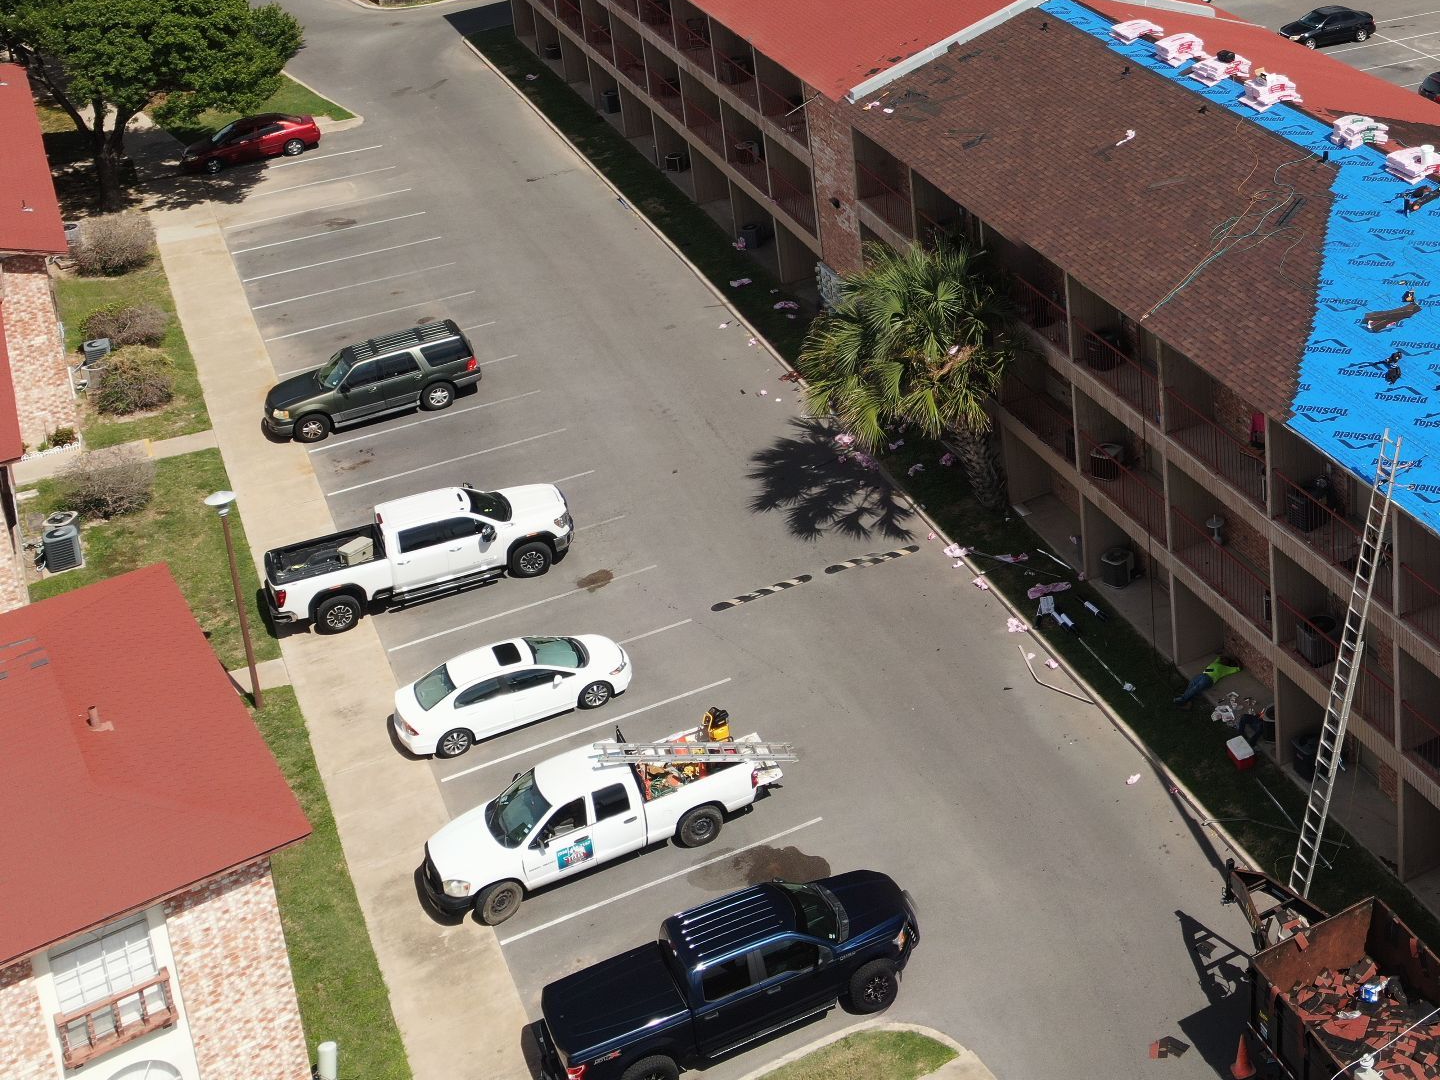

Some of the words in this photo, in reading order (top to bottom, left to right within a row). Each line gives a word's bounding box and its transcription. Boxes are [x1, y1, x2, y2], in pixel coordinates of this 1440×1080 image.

[1331, 159, 1375, 167] TopShield
[1347, 259, 1396, 267] TopShield
[1319, 297, 1369, 306] TopShield
[1374, 392, 1429, 404] TopShield
[1295, 404, 1349, 417] TopShield
